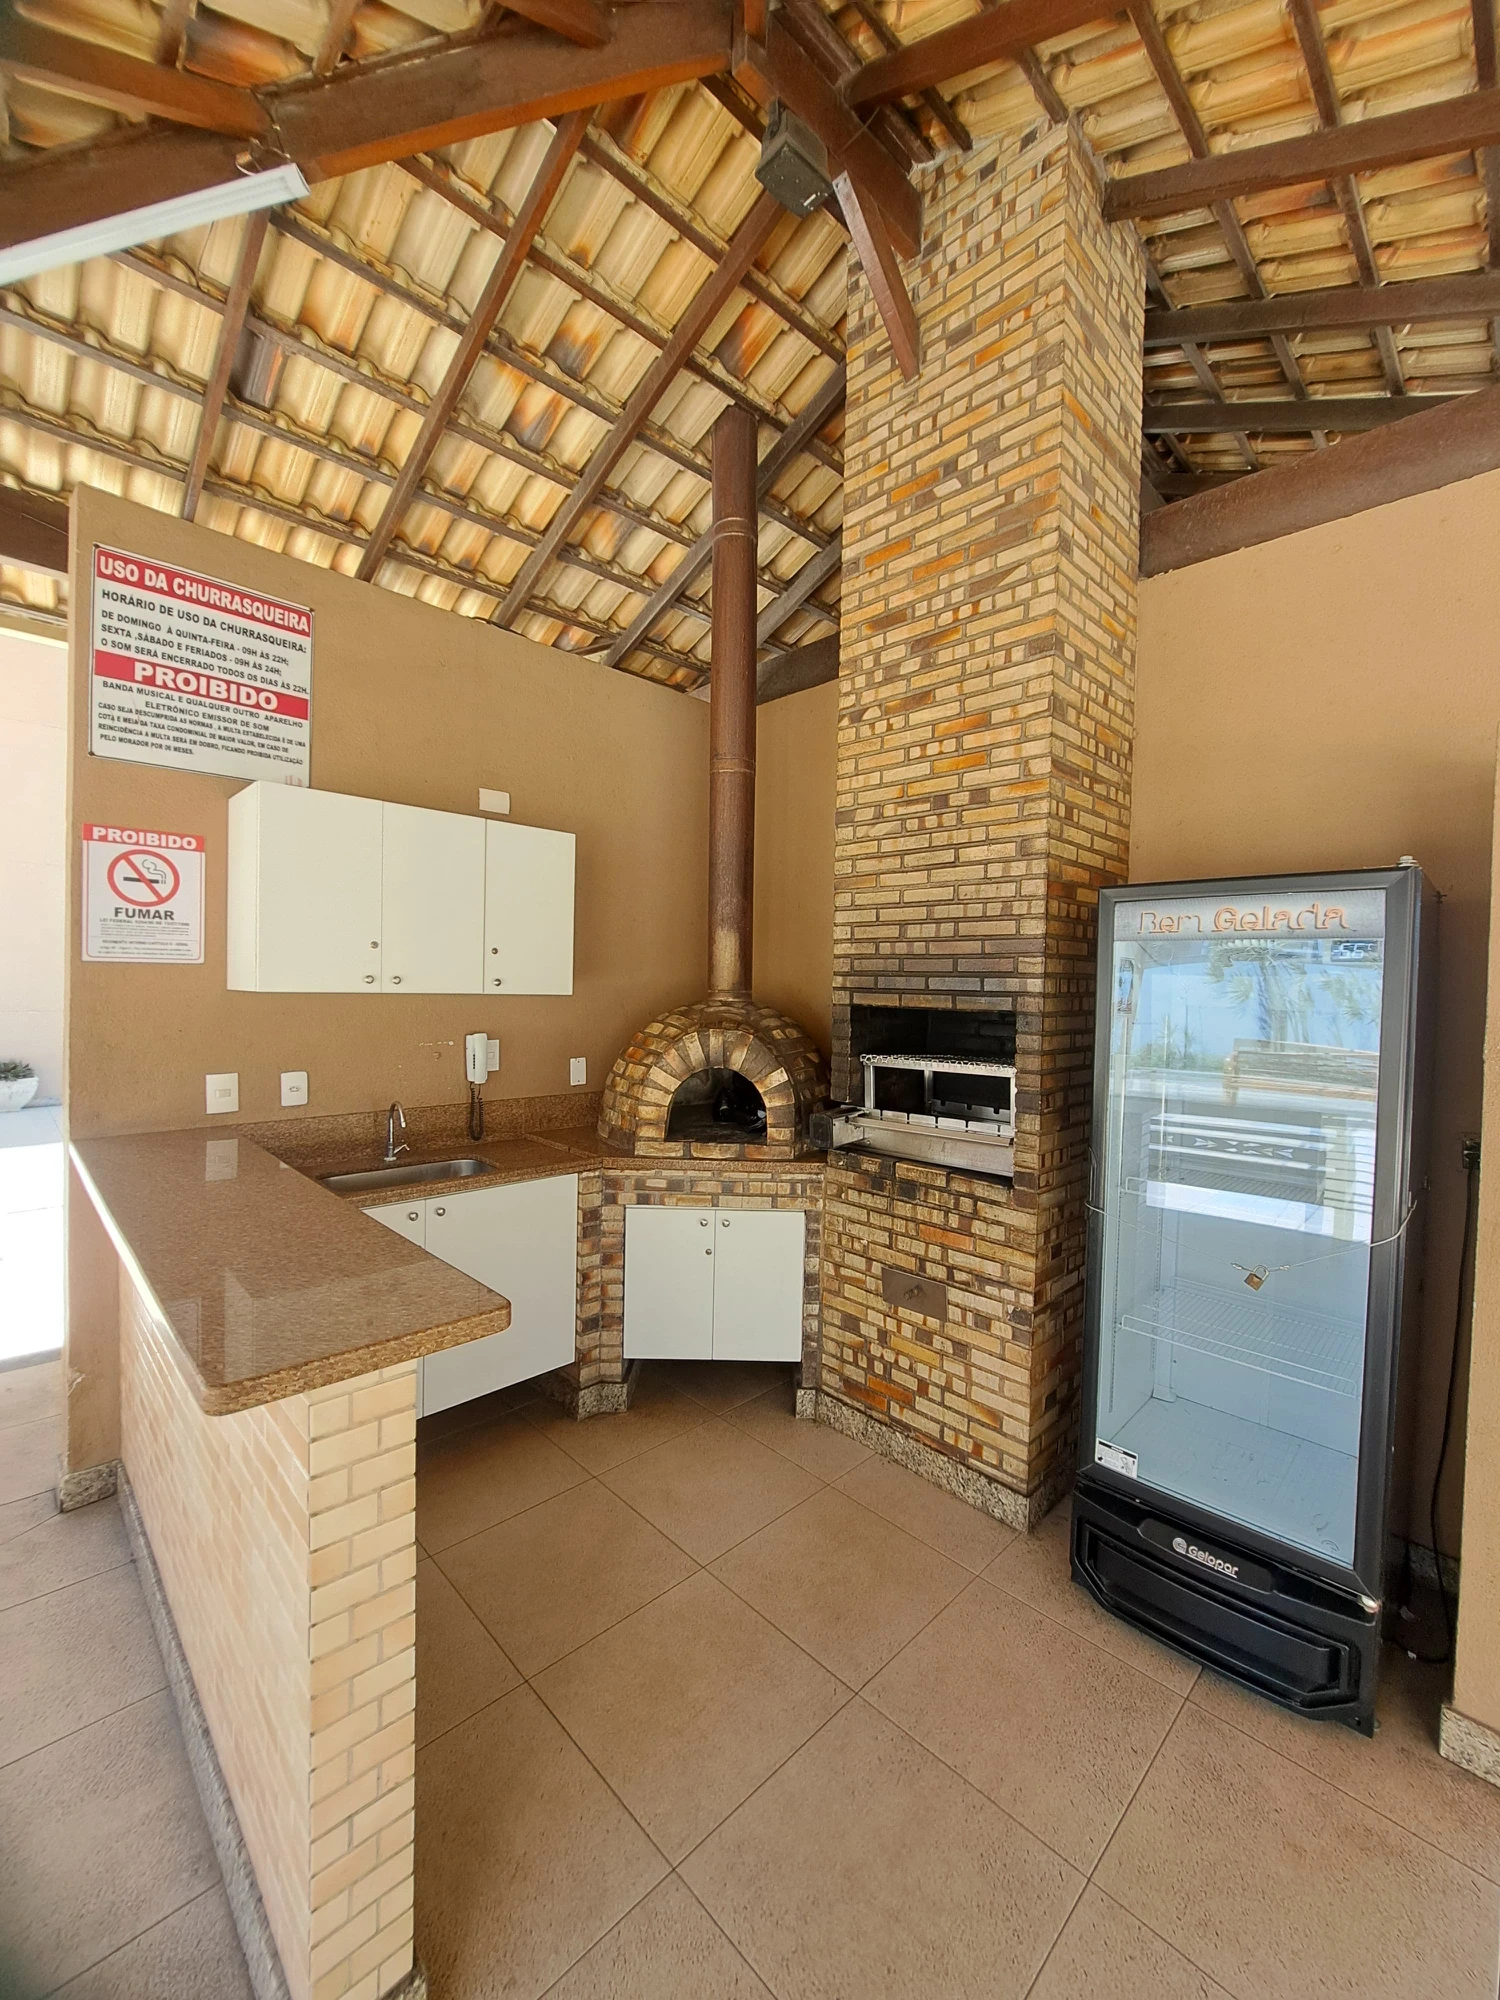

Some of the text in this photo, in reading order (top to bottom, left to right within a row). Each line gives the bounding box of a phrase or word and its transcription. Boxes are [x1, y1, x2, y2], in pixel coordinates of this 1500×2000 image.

[100, 555, 309, 633] USO DA CHURRASQUEIRA
[102, 589, 306, 653] HORÁRIO DE USO DA CHURRASQUEIRA:
[102, 610, 114, 620] DE
[118, 614, 161, 632] DOMINGO
[176, 629, 235, 651] QUINTA-FEIRA
[242, 647, 257, 657] 09H
[272, 655, 289, 666] 22H;
[101, 638, 108, 646] O
[111, 640, 131, 652] SOM
[135, 646, 158, 658] SERÁ
[162, 652, 214, 671] ENCERRADO
[218, 666, 244, 679] TODOS
[247, 673, 257, 682] OS
[261, 677, 278, 687] DIAS
[293, 685, 308, 694] 22H.
[102, 624, 132, 638] SEXTA
[186, 645, 227, 662] FERIADOS
[235, 658, 249, 667] 09H
[265, 665, 281, 676] 24H;
[103, 681, 134, 693] BANDA
[137, 687, 175, 701] MUSICAL
[186, 698, 230, 713] QUALQUER
[233, 708, 259, 719] OUTRO
[265, 715, 303, 728] APARELHO
[134, 662, 278, 712] PROIBIDO
[99, 702, 115, 711] CASO
[118, 706, 133, 714] SEJA
[135, 709, 177, 722] DESCUMPRIDA
[189, 719, 213, 729] NORMAS
[243, 730, 280, 742] ESTABELECIDA
[145, 701, 199, 718] ELETRÔNICO
[202, 712, 238, 725] EMISSOR
[253, 723, 269, 732] SOM
[167, 725, 207, 737] CONDOMINIAL
[119, 737, 149, 747] MORADOR
[151, 733, 170, 741] MULTA
[222, 745, 245, 754] FICANDO
[247, 750, 271, 759] PROIBIDA
[92, 826, 197, 850] PROIBIDO
[114, 907, 175, 921] FUMAR
[1212, 901, 1352, 933] Gelada
[1188, 1546, 1239, 1575] Gelopar
